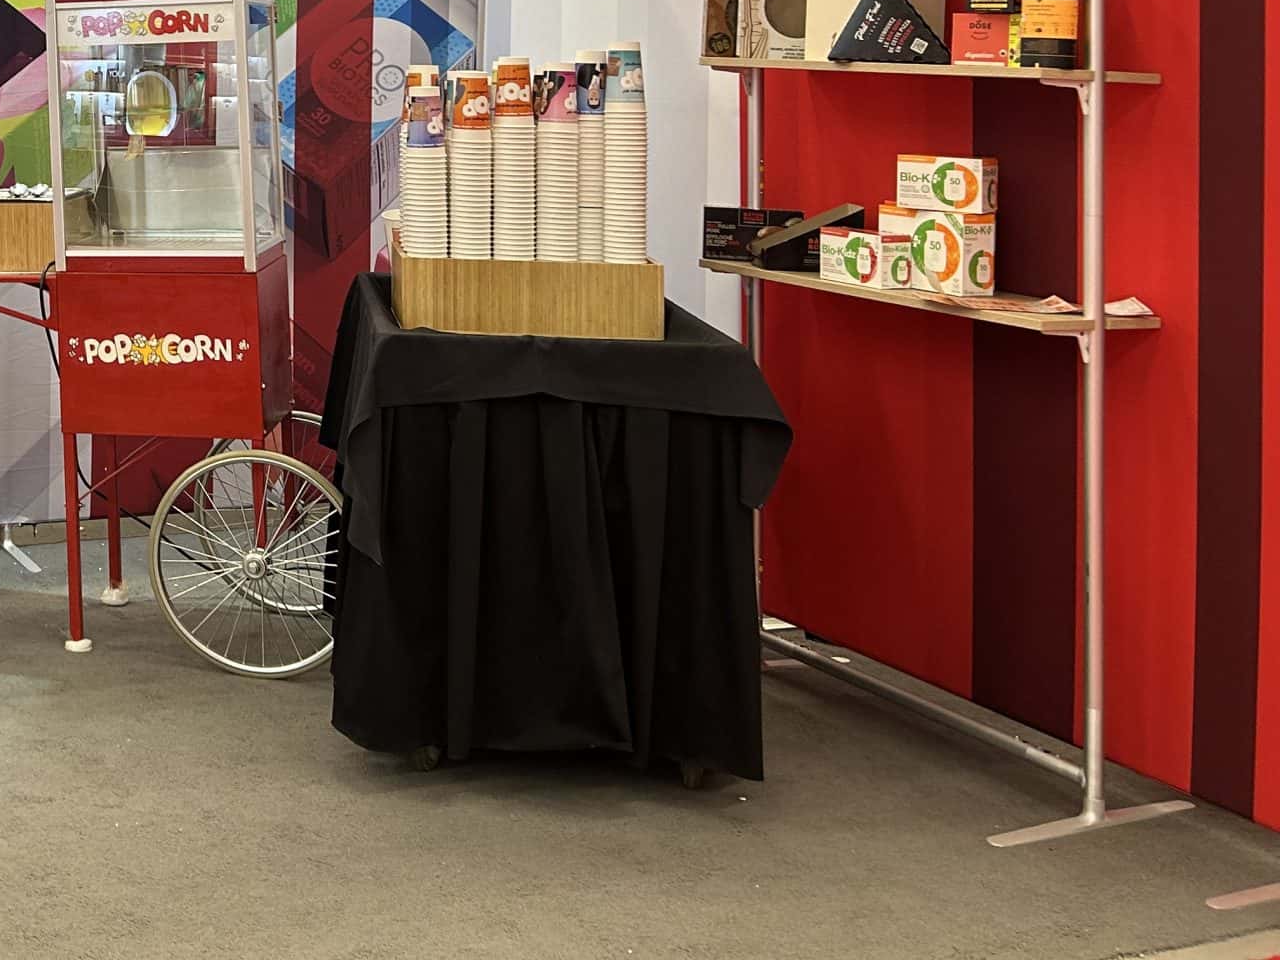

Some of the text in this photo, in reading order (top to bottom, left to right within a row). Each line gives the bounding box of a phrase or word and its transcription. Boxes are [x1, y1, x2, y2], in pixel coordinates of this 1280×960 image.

[81, 8, 211, 38] POP CORN
[949, 178, 961, 186] 50
[84, 334, 233, 365] POP CORN
